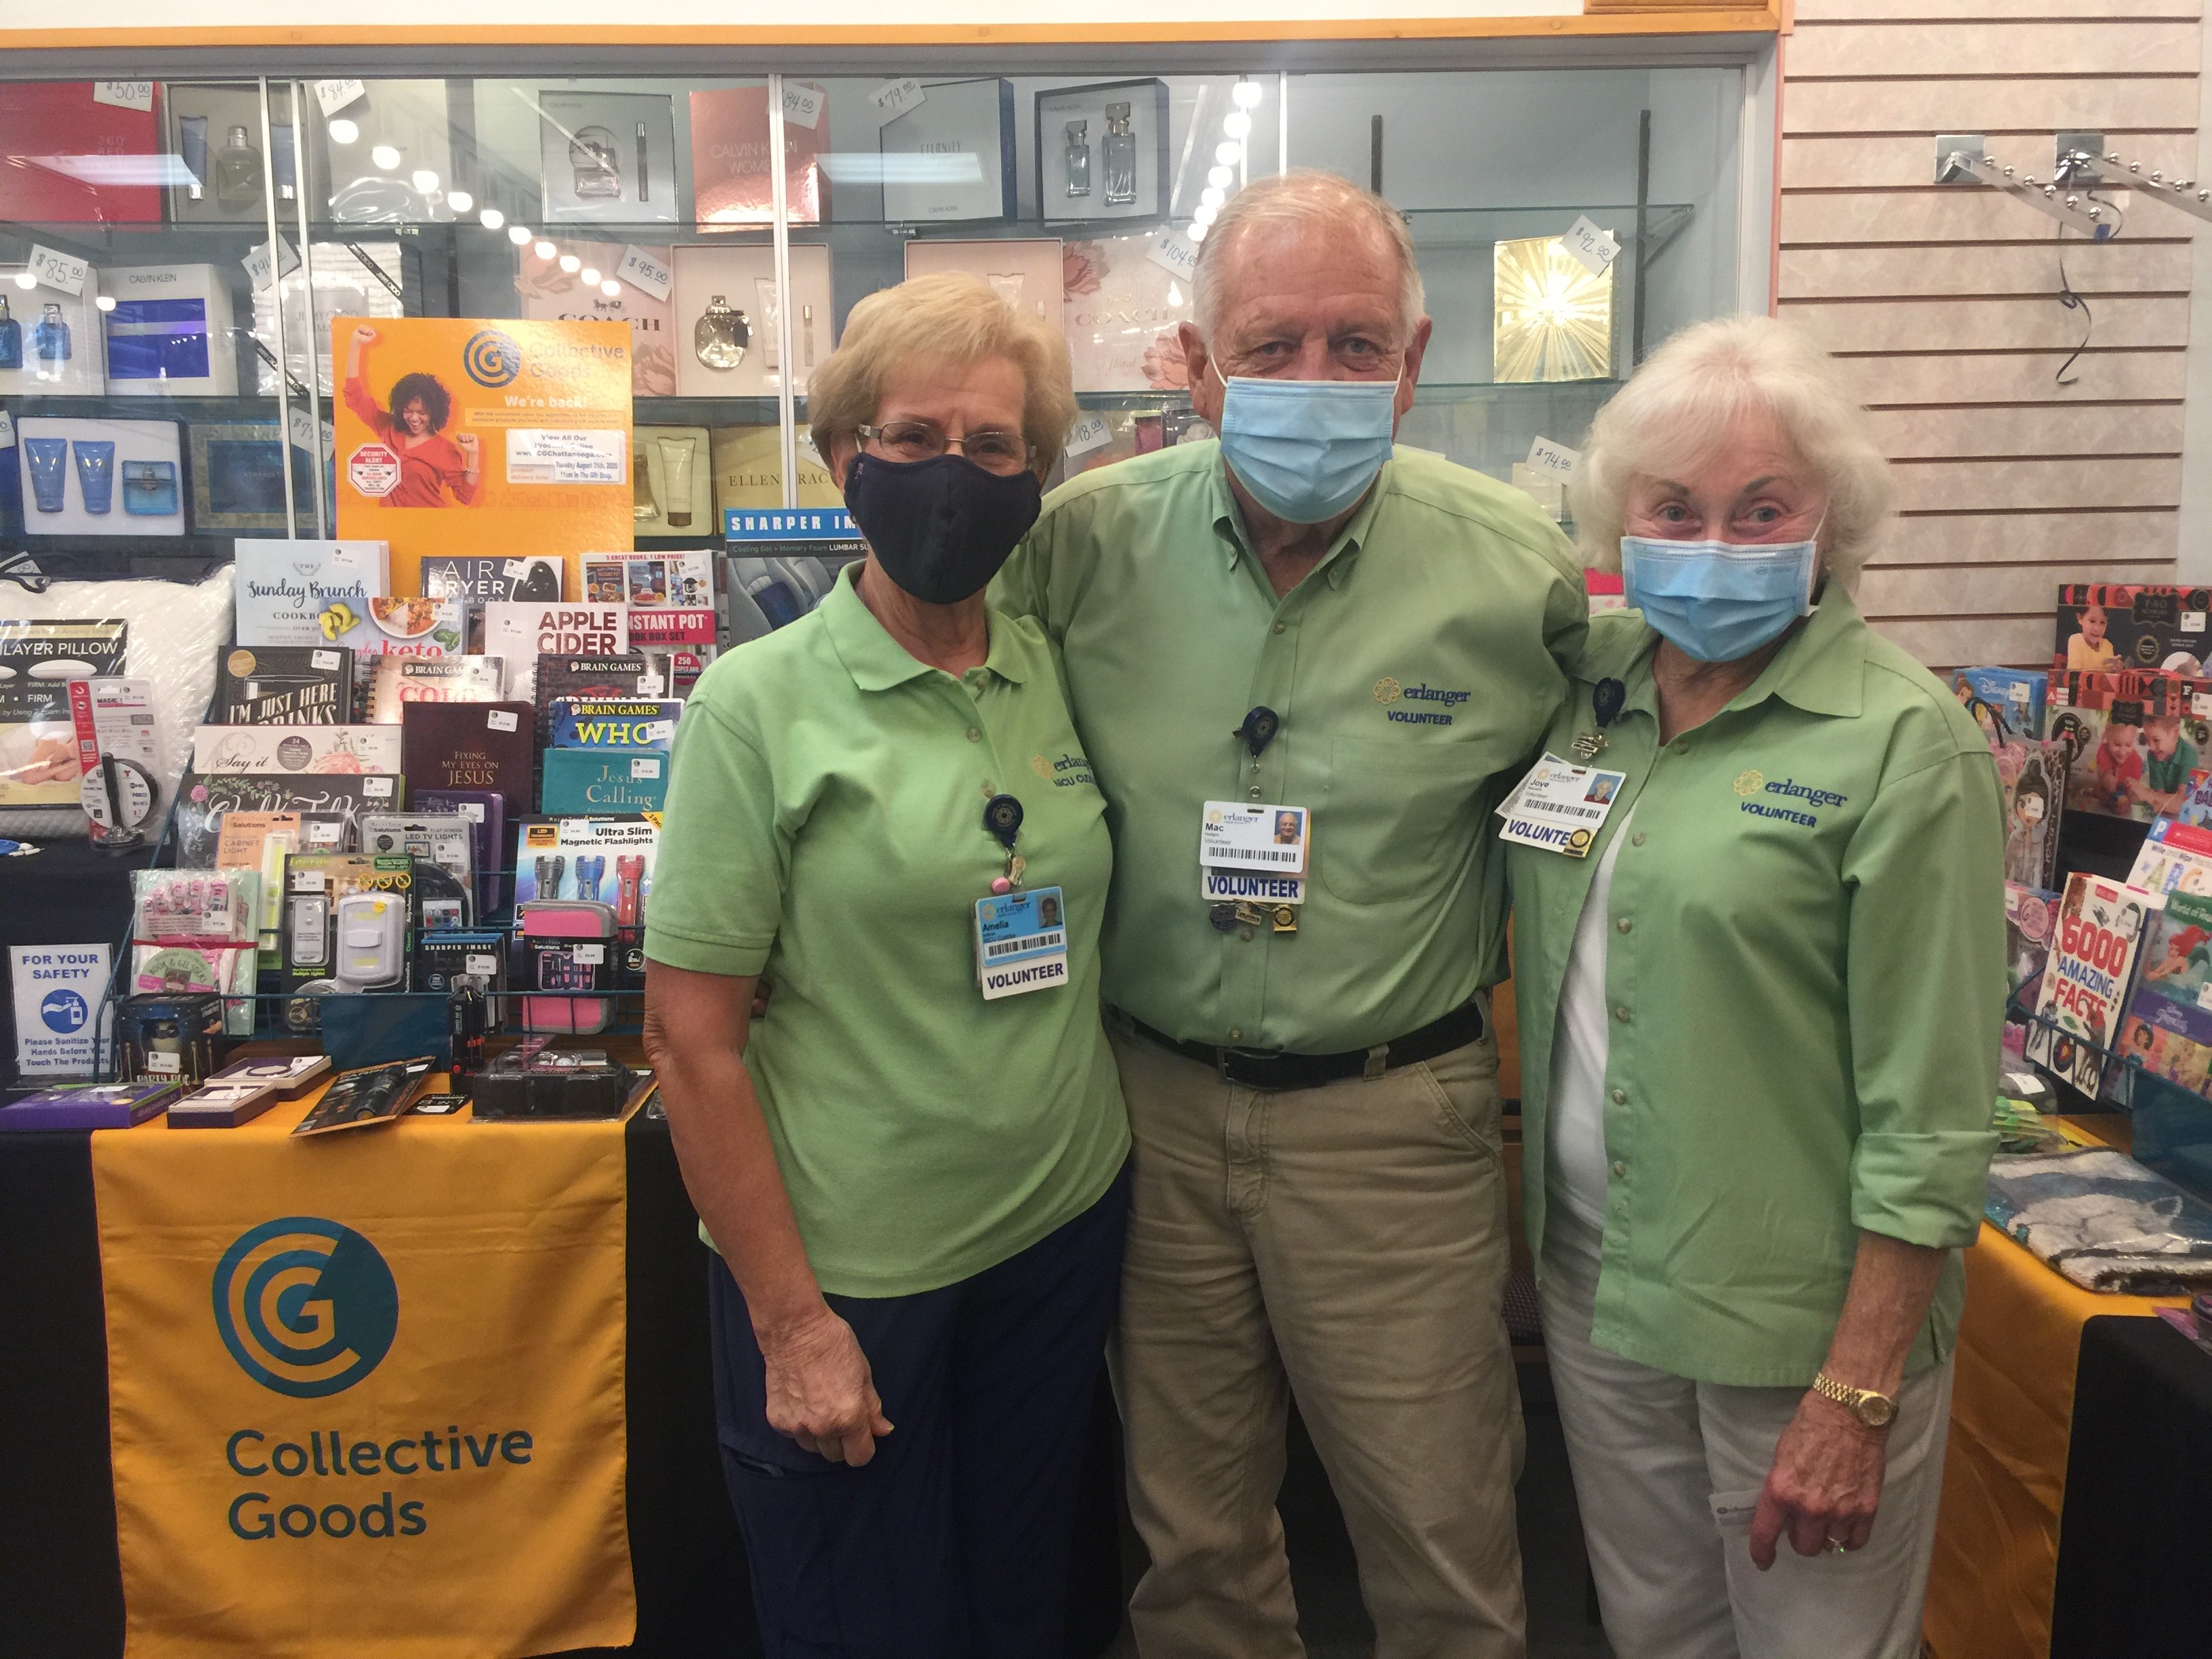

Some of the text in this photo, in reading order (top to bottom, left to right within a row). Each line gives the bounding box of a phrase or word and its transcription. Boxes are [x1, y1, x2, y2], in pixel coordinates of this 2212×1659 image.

[783, 91, 813, 113] 84.00
[712, 142, 758, 159] CALVIN
[920, 141, 961, 155] ETERNITY
[729, 161, 771, 173] WOME
[1576, 226, 1610, 263] $92.00
[36, 253, 84, 284] $85.00
[628, 256, 668, 285] $95.00
[129, 274, 177, 284] CALVIN KLEIN
[1075, 308, 1168, 326] COACH
[531, 342, 624, 359] Collective
[530, 363, 591, 379] Goods
[504, 395, 586, 407] We're back!
[556, 462, 575, 470] Tuesday
[1536, 447, 1572, 470] $74.00
[729, 474, 779, 487] ELLEN
[731, 515, 856, 531] SHARPER IM
[733, 546, 759, 554] Cooling
[779, 546, 808, 554] Memory
[442, 560, 495, 579] AIR
[247, 578, 367, 609] Sunday Brunch
[445, 580, 505, 595] RYER
[538, 611, 617, 631] APPLE
[679, 614, 705, 630] POT
[537, 632, 617, 655] CIDER
[649, 632, 686, 640] BOX SET
[0, 642, 119, 656] LAYER PILLOW
[381, 640, 442, 656] keto
[581, 663, 641, 672] BRAIN GAMES
[678, 657, 691, 665] 250
[415, 665, 443, 675] BRAIN
[28, 694, 53, 703] FIRM
[229, 682, 337, 724] I'M JUST HERE
[1404, 683, 1471, 708] erlanger
[581, 705, 657, 716] BRAIN GAMES
[1387, 711, 1453, 726] VOLUNTEER
[216, 753, 269, 774] Say it
[455, 751, 487, 760] FIXING
[442, 761, 499, 769] MY EYES ON
[447, 771, 494, 786] JESUS
[586, 785, 653, 811] Calling
[1764, 778, 1848, 807] erlanger
[1224, 813, 1259, 824] erlanger
[1740, 802, 1818, 828] VOLUNTEER
[596, 827, 653, 836] Ultra Slim
[1205, 823, 1224, 832] Mac
[1508, 819, 1572, 846] VOLUNTE
[560, 838, 602, 846] Magnetic
[605, 838, 654, 846] Flashlights
[1204, 837, 1232, 846] Volunteer
[1208, 876, 1298, 899] VOLUNTEER
[982, 920, 1009, 933] Amelia
[2062, 914, 2129, 978] 6000
[22, 954, 99, 965] FOR YOUR
[33, 968, 91, 979] SAFETY
[987, 962, 1064, 991] VOLUNTEER
[2057, 956, 2115, 998] AMAZING
[2054, 978, 2107, 1022] FACTS
[137, 1074, 169, 1084] PARTY
[226, 1425, 533, 1477] Collective
[228, 1492, 428, 1540] Goods
